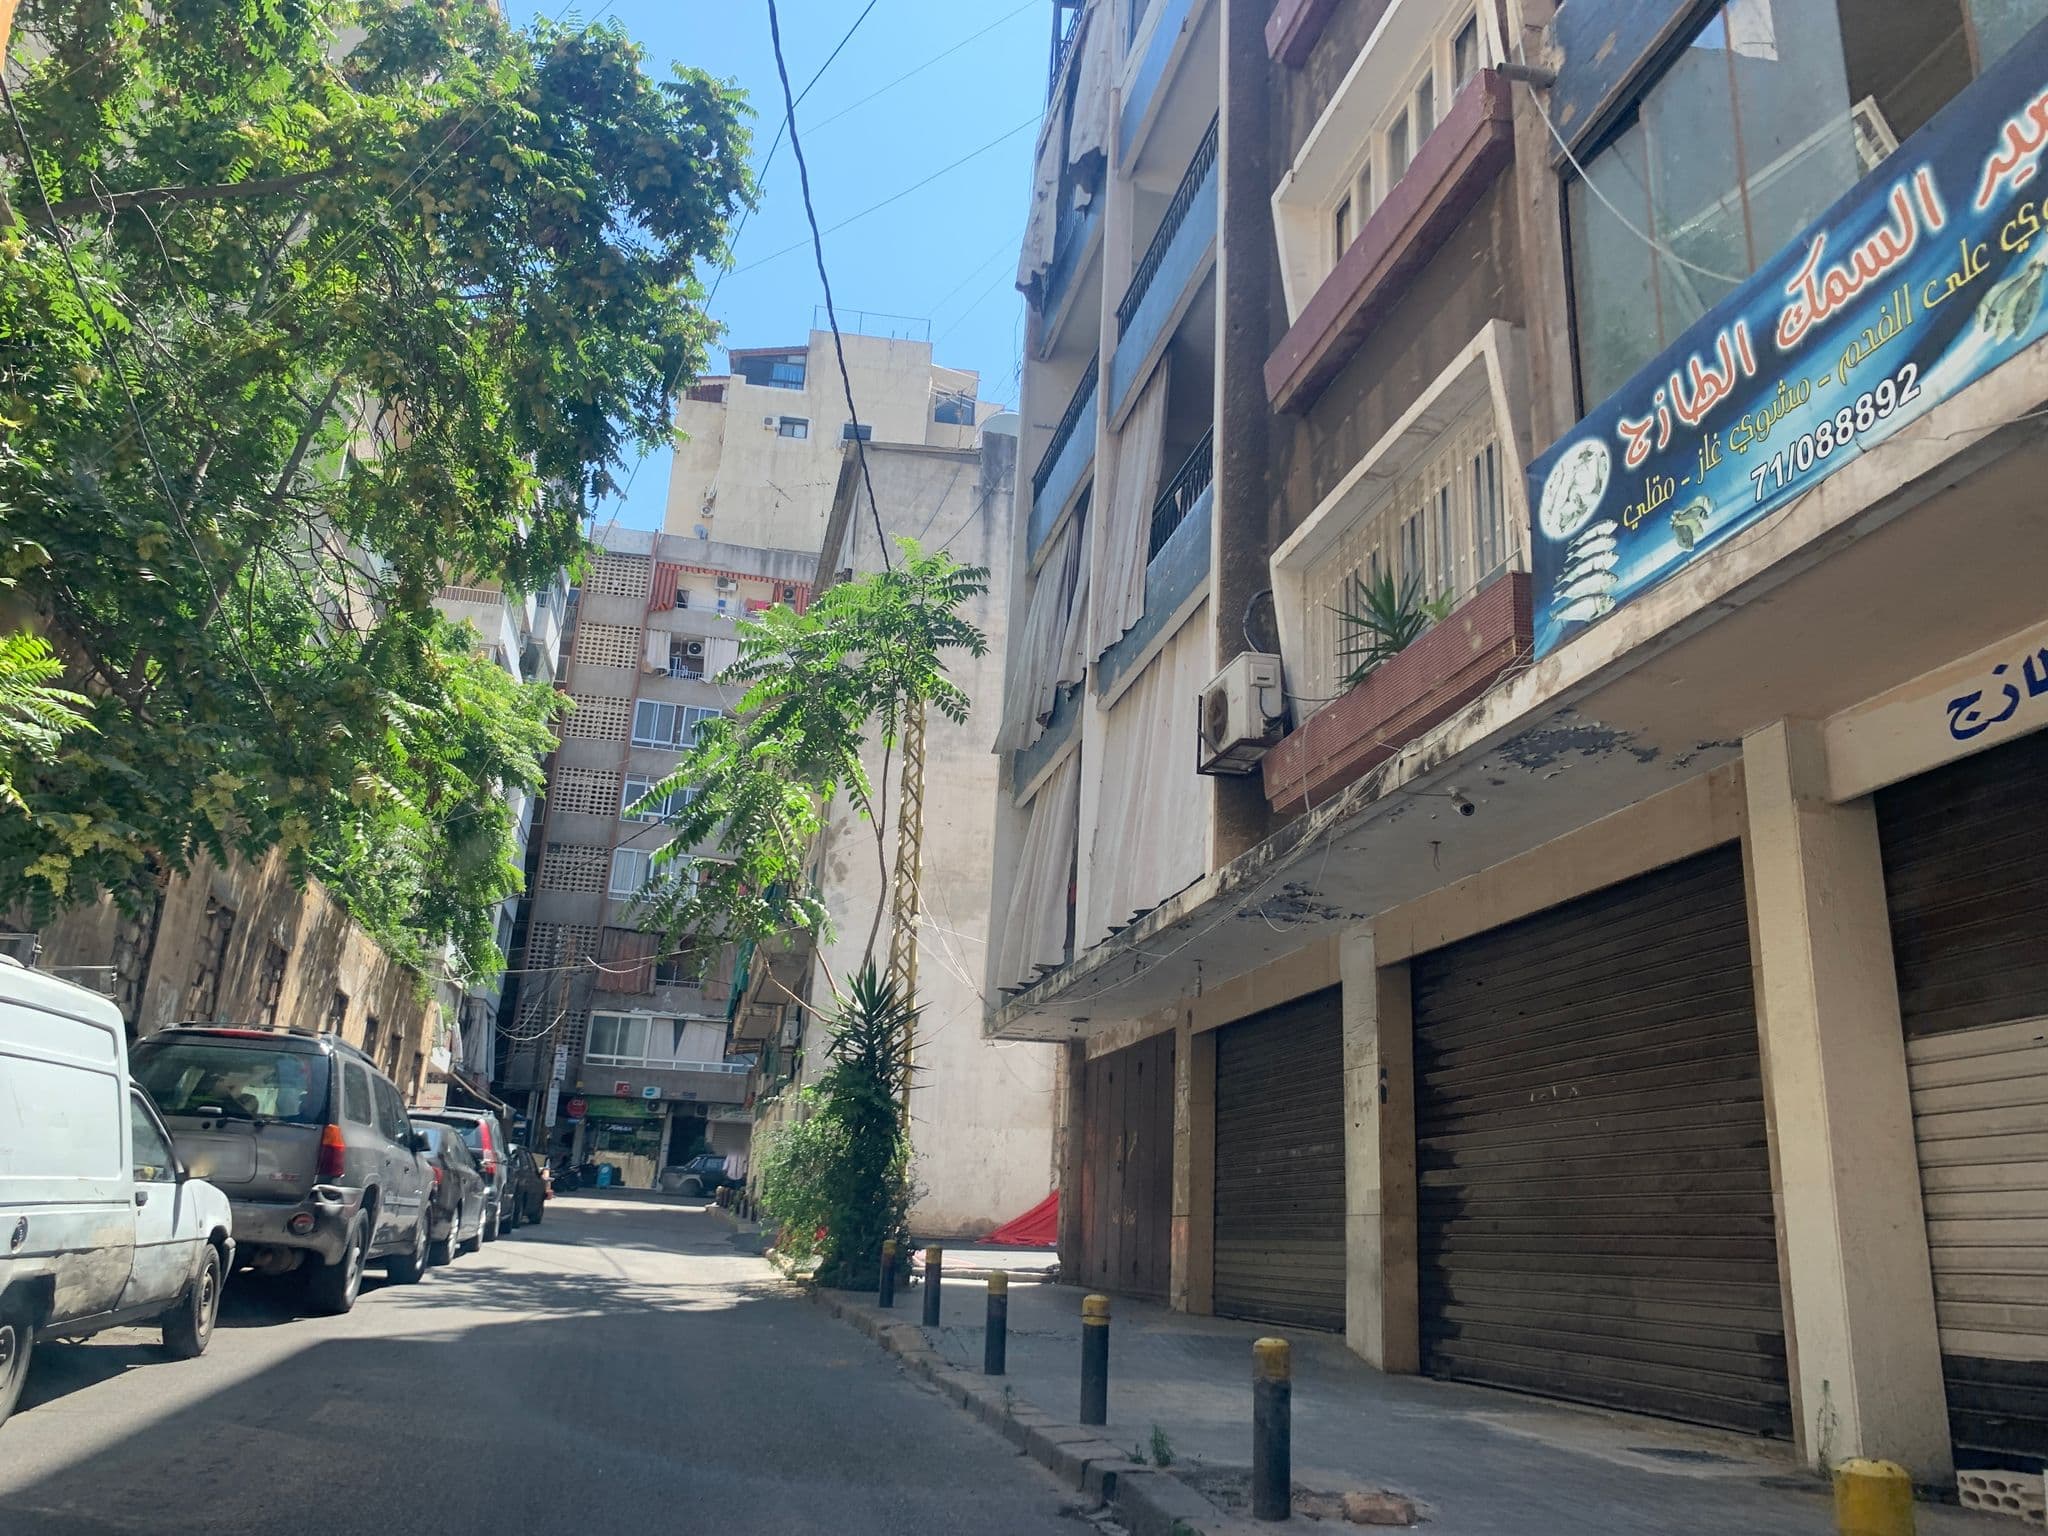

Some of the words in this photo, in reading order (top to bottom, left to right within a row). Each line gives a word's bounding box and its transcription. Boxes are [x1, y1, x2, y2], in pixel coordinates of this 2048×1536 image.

[1776, 168, 1944, 348] السمك
[1922, 238, 1990, 309] على
[1838, 282, 1913, 386] الفحم
[1617, 320, 1757, 468] الطازج
[1728, 378, 1811, 455] مشوي
[1750, 362, 1922, 502] 71/088892
[1622, 474, 1676, 531] مقلي
[1697, 431, 1723, 485] غاز
